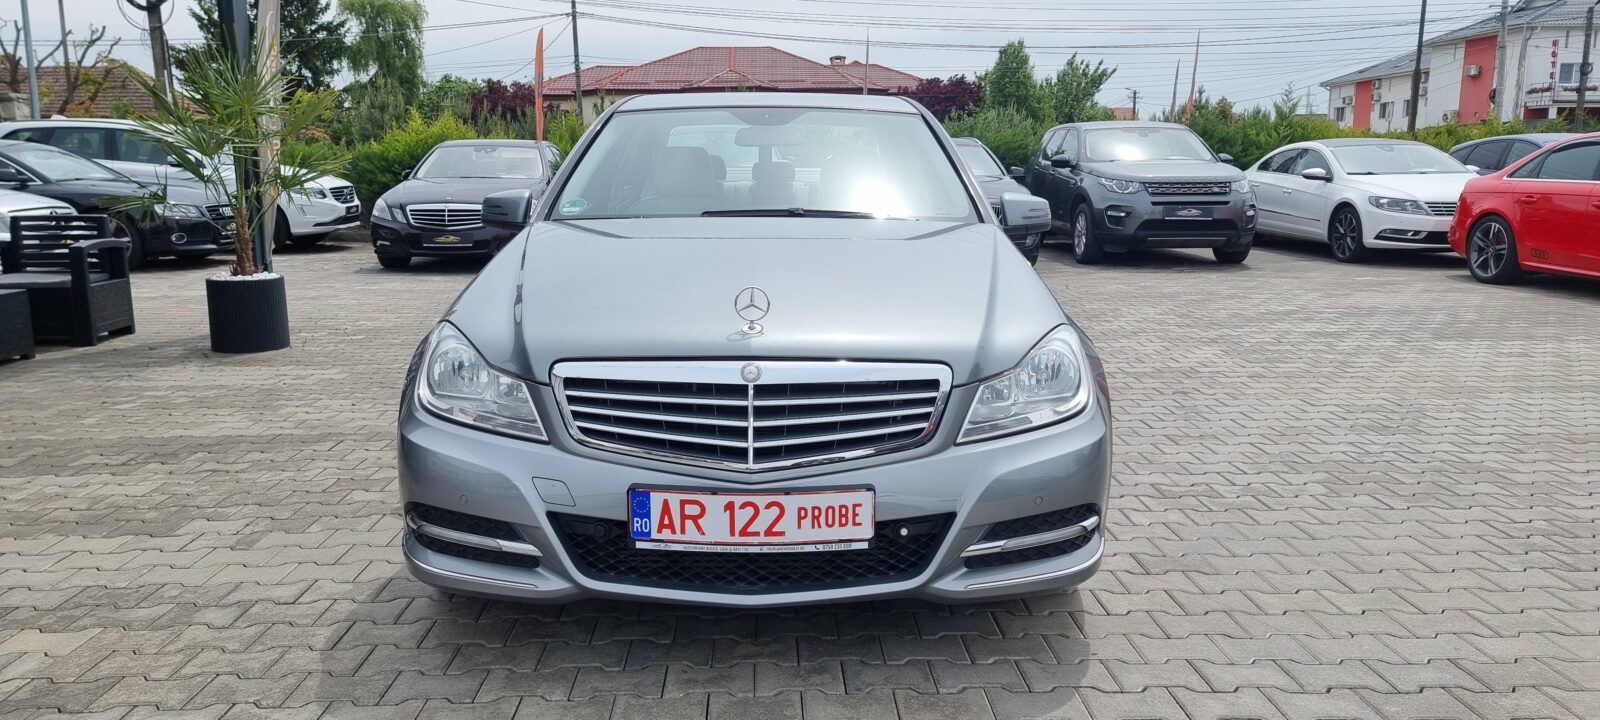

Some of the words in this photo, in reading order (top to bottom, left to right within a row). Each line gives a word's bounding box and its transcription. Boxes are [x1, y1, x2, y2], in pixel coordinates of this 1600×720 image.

[634, 517, 650, 533] RO
[656, 498, 707, 536] AR
[723, 500, 786, 537] 122
[796, 503, 863, 530] PROBE
